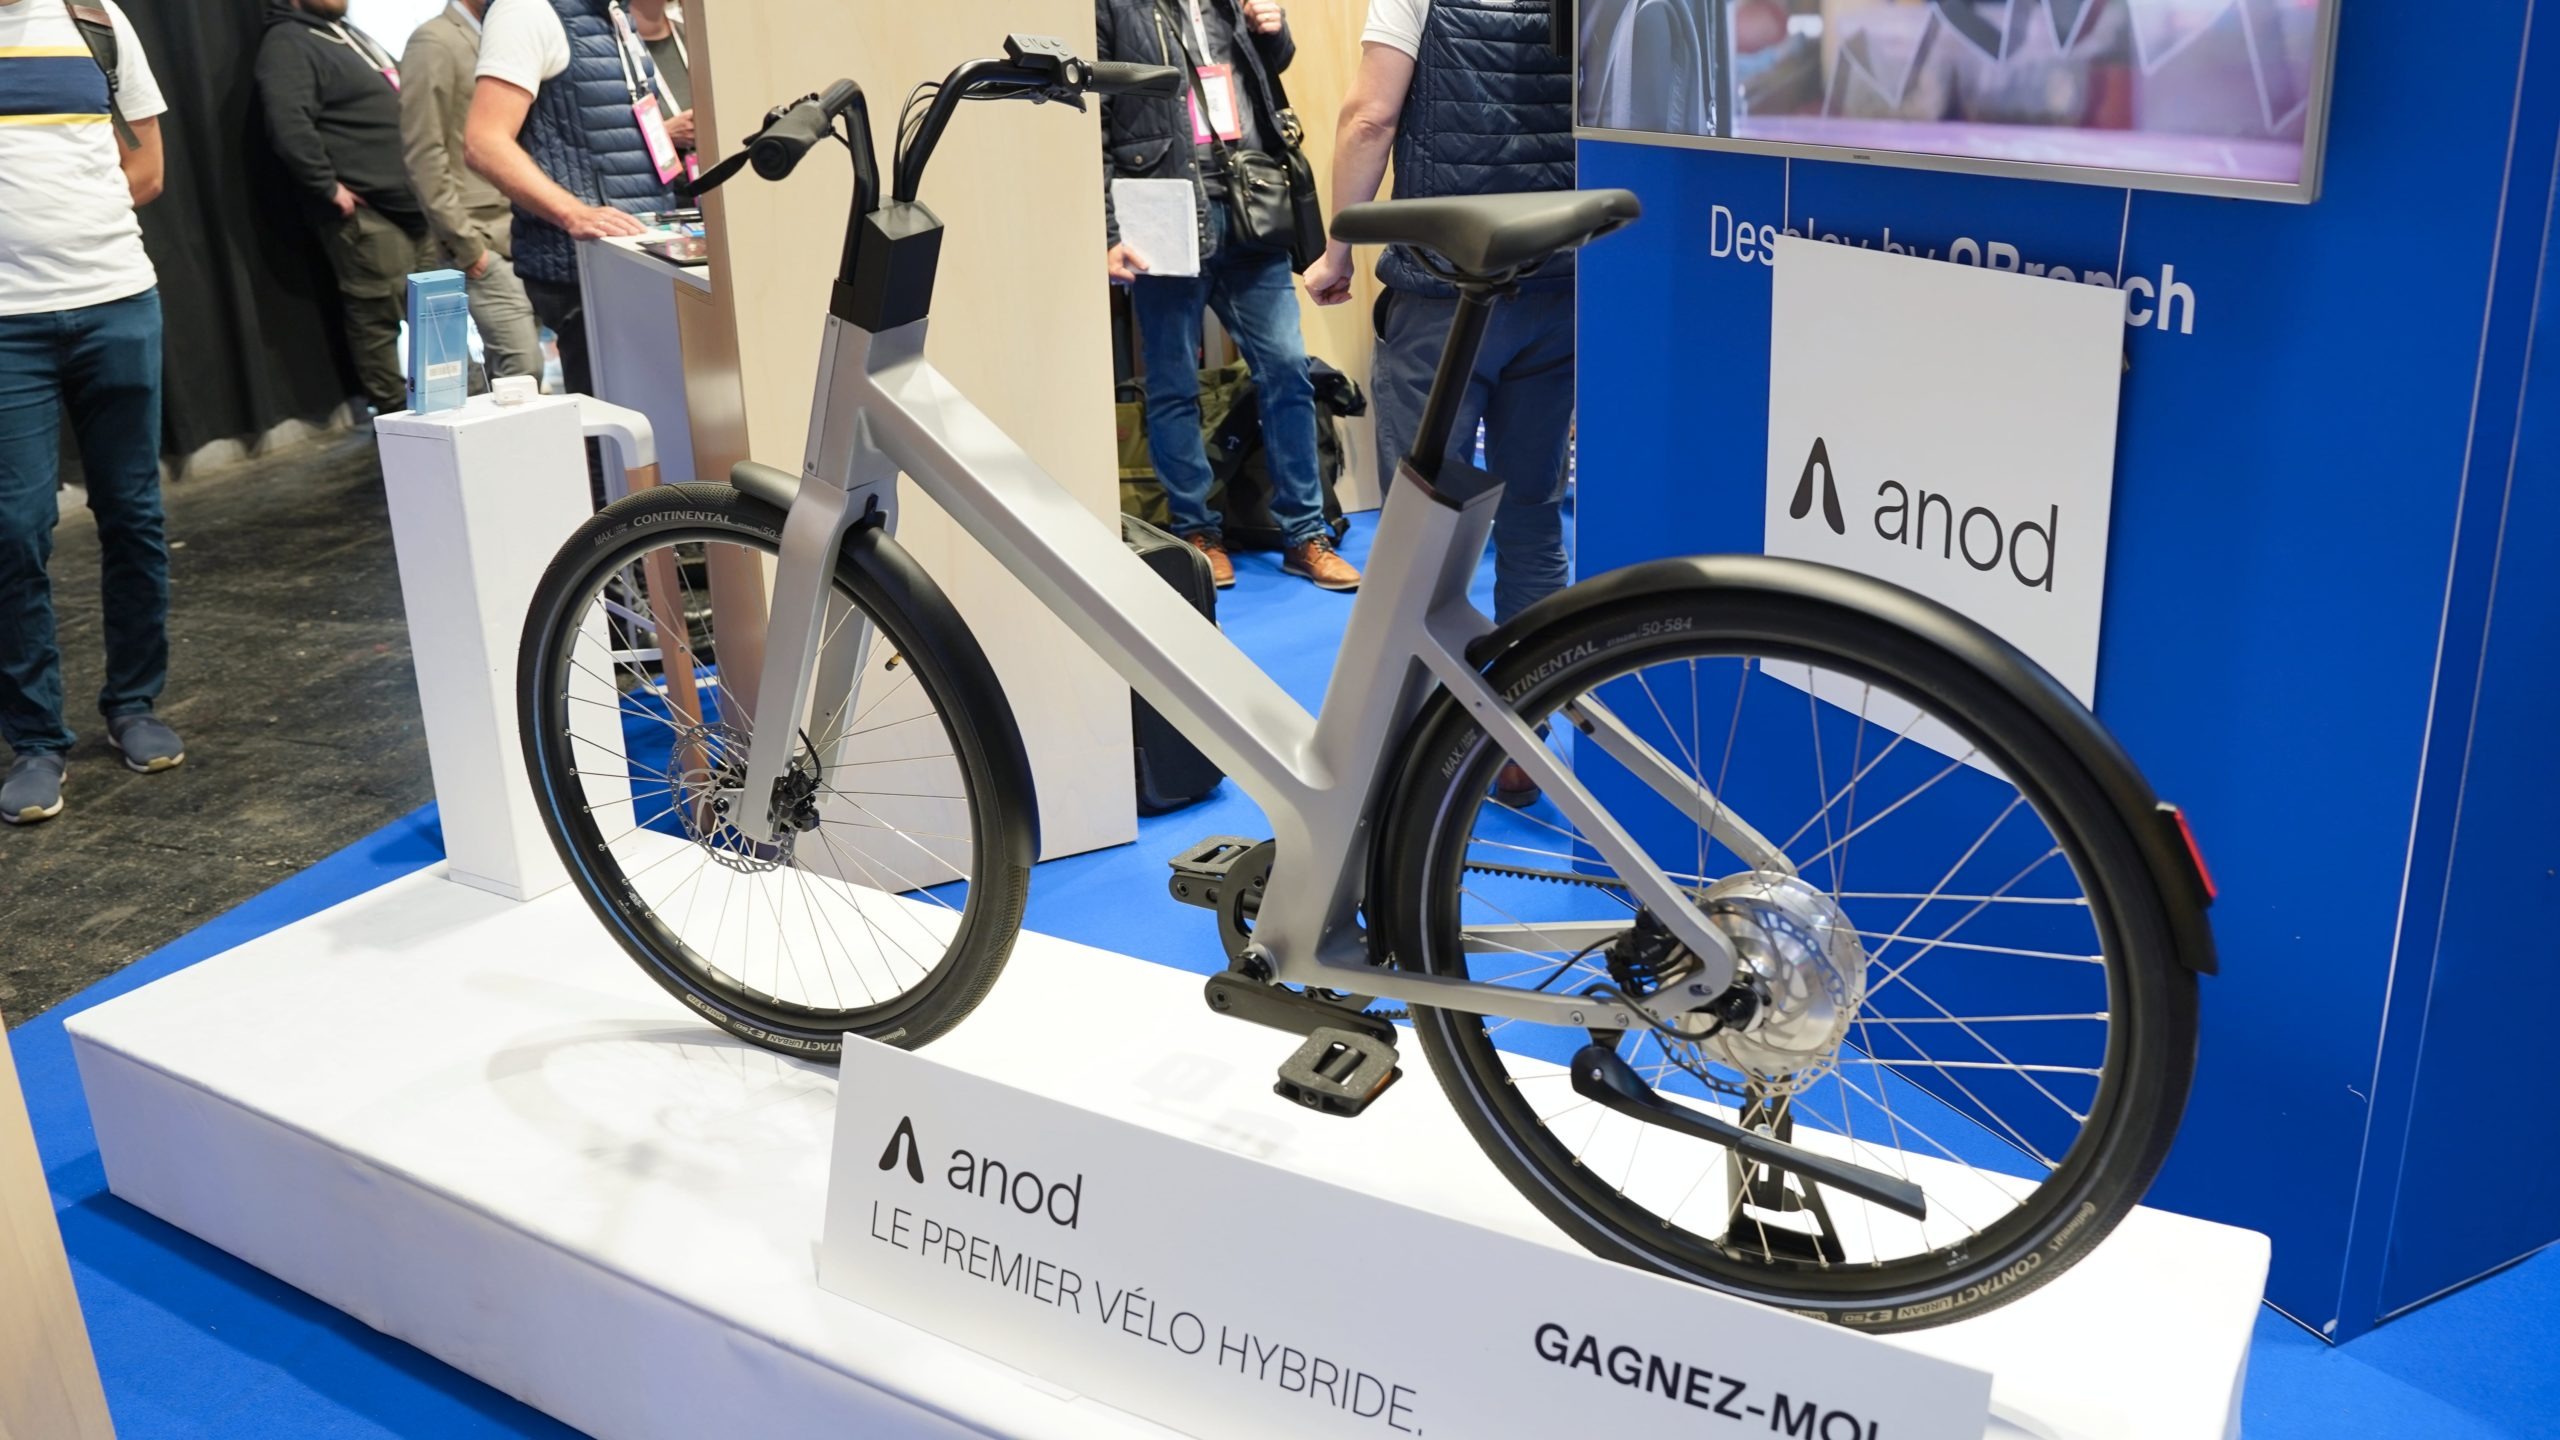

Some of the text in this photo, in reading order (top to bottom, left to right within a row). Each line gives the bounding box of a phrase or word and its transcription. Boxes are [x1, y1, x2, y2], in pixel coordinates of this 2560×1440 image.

[633, 510, 732, 527] CONTINENTAL
[1873, 479, 2059, 593] anod
[1641, 616, 1693, 637] 50-584
[1502, 640, 1599, 704] NTINENTAL
[768, 1034, 802, 1048] URBAN
[946, 1148, 1083, 1230] anod
[1954, 1252, 2043, 1307] CONTACT
[871, 1199, 1424, 1437] LE PREMIER VÉLO HYBRIDE.
[1899, 1297, 1952, 1318] URBAN
